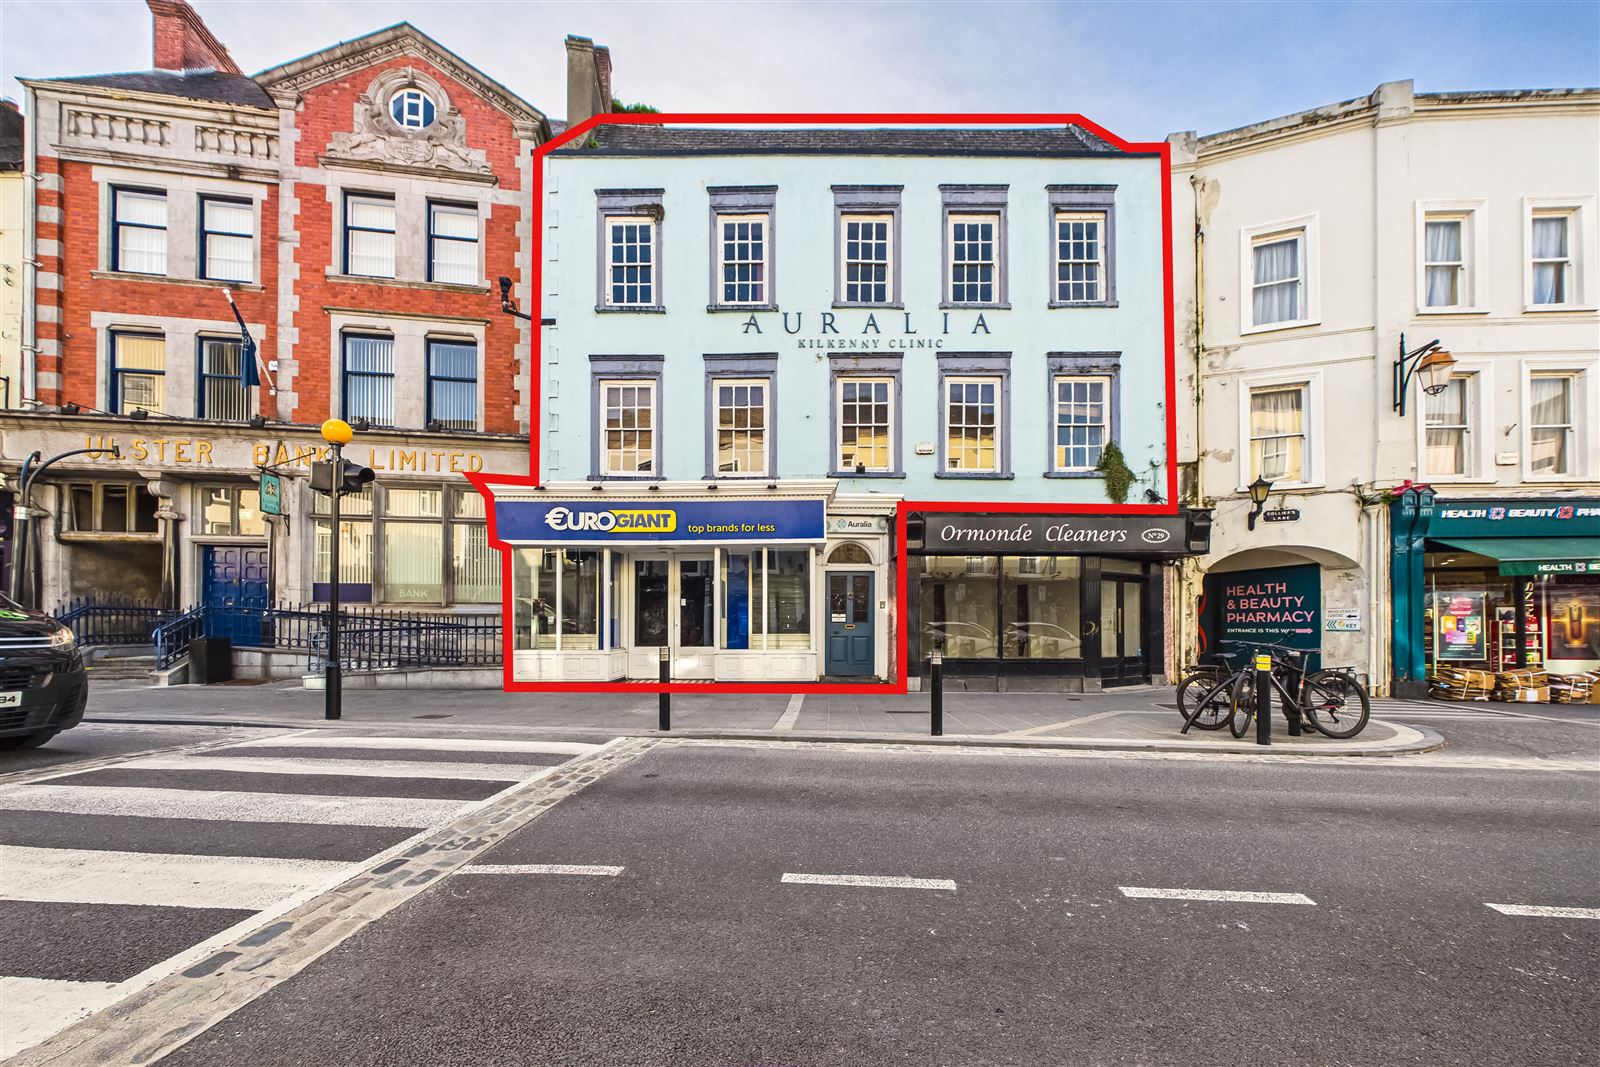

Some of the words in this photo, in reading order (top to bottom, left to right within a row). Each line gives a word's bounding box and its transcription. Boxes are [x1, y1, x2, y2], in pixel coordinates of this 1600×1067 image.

[743, 312, 992, 334] AURALIA
[798, 339, 880, 348] KILKENNY
[889, 339, 944, 348] CLINIC
[85, 436, 213, 463] ULSTER
[253, 444, 330, 466] BANK
[370, 449, 483, 473] LIMITED
[1441, 509, 1487, 518] HEALTH
[1508, 508, 1556, 517] BEAUTY
[688, 524, 704, 534] top
[706, 523, 739, 532] brands
[741, 523, 755, 532] for
[757, 523, 775, 532] less
[847, 520, 872, 528] Auralia
[941, 523, 1032, 542] Ormonde
[1045, 523, 1128, 542] Cleaners
[399, 589, 428, 598] BANK
[1226, 582, 1287, 597] HEALTH
[1226, 599, 1236, 610] &
[1240, 596, 1304, 610] BEAUTY
[1227, 610, 1314, 623] PHARMACY
